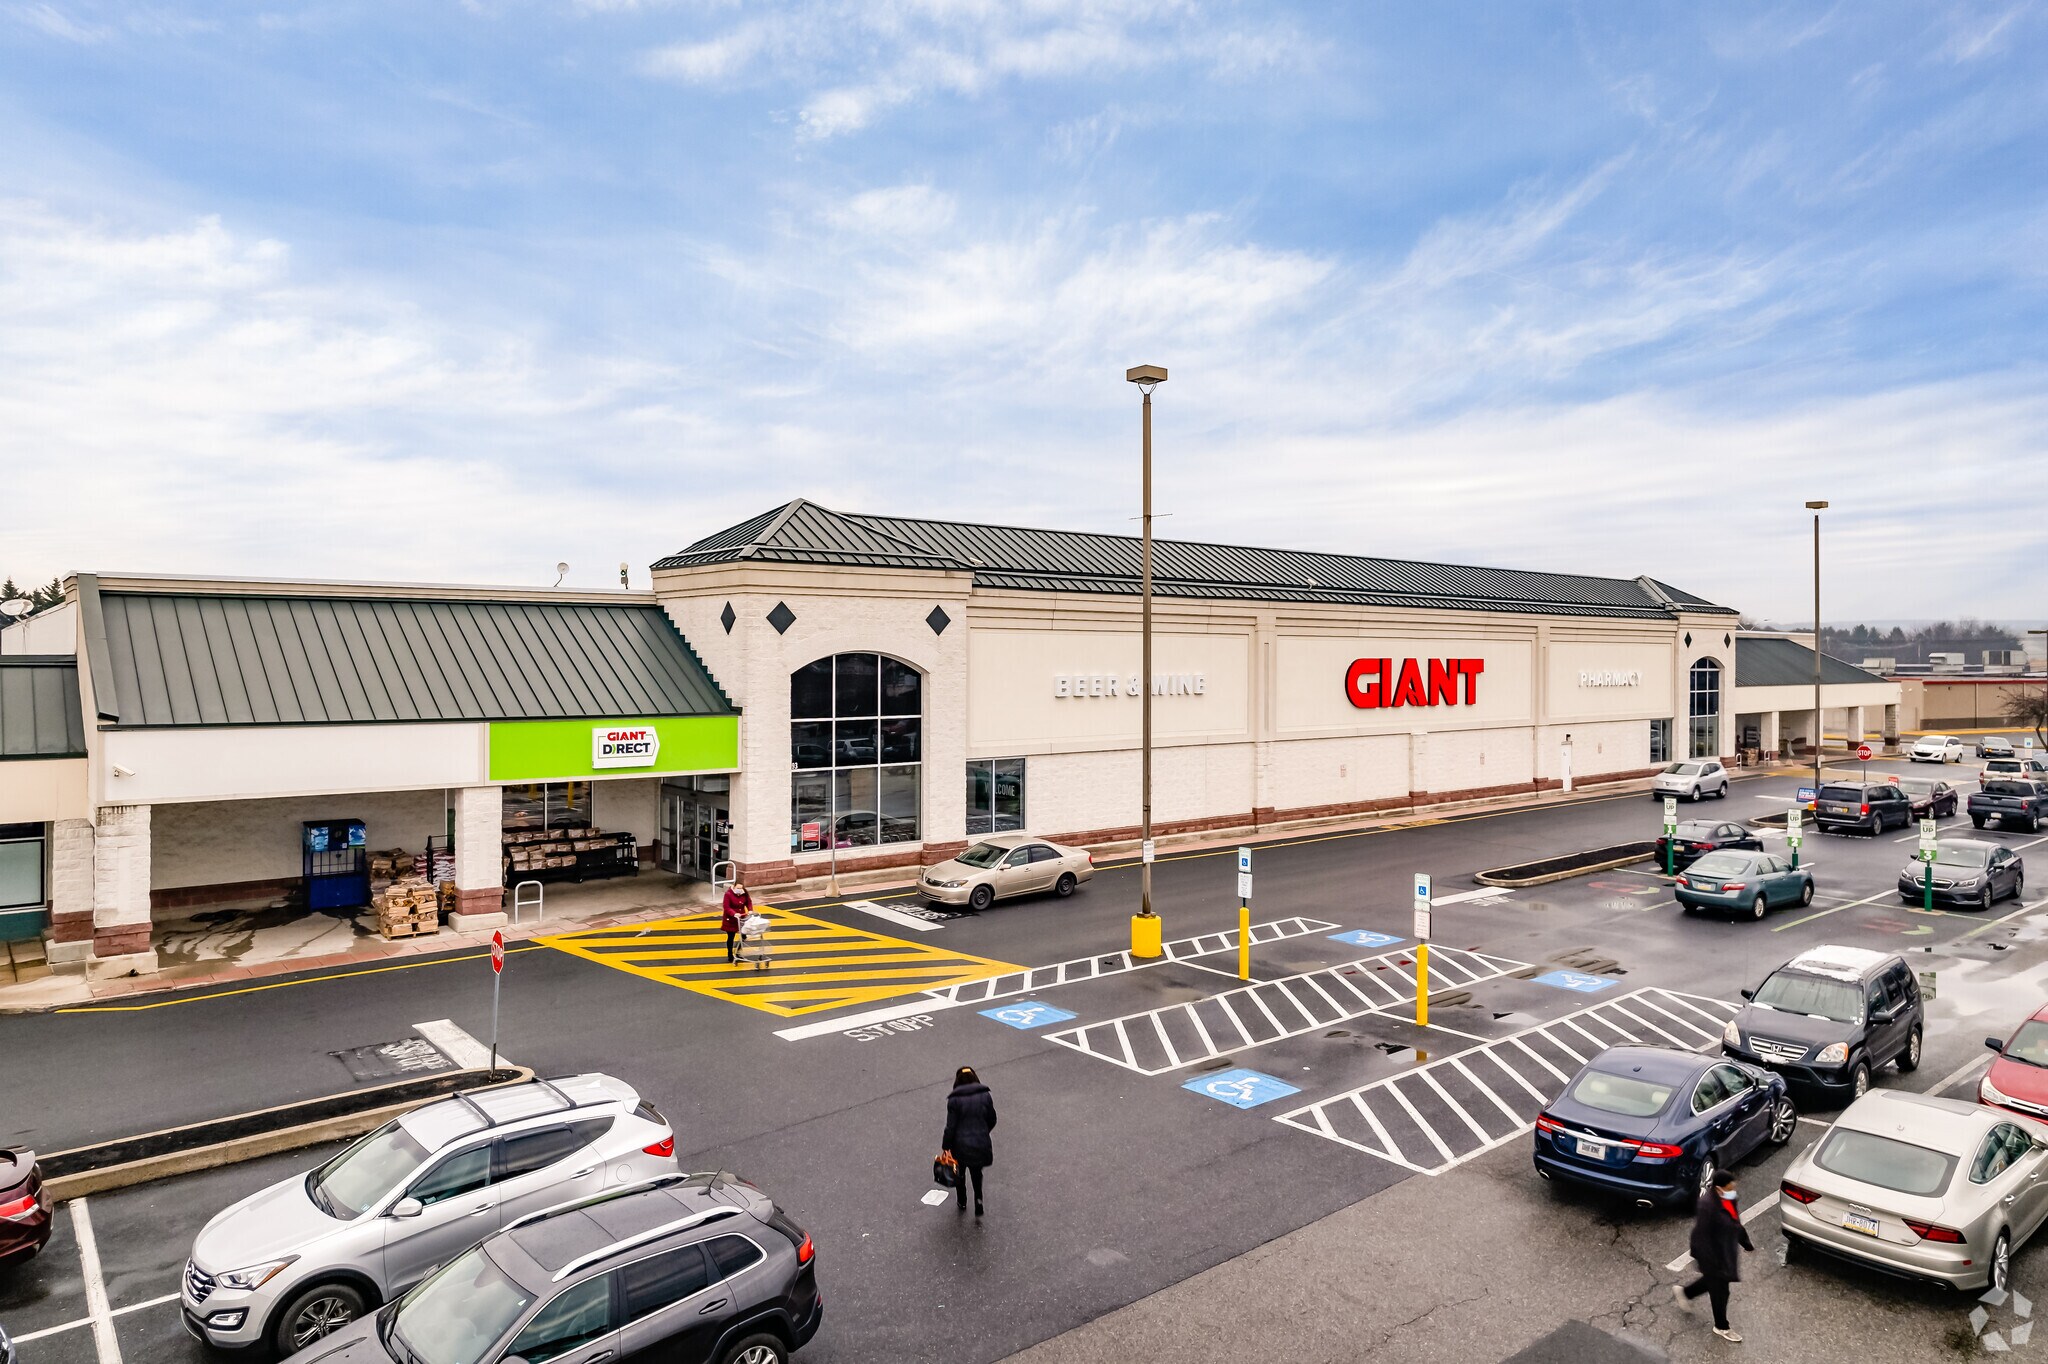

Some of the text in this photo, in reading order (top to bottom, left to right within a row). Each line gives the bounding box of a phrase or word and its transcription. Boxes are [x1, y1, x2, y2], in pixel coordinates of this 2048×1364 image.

[1054, 674, 1207, 698] BEER & WINE
[1345, 658, 1484, 708] GIANT
[1577, 671, 1643, 688] PHARMACY
[607, 731, 647, 741] GIANT
[984, 781, 1016, 797] WCOME
[1791, 837, 1799, 847] 2
[1923, 850, 1933, 860] 3
